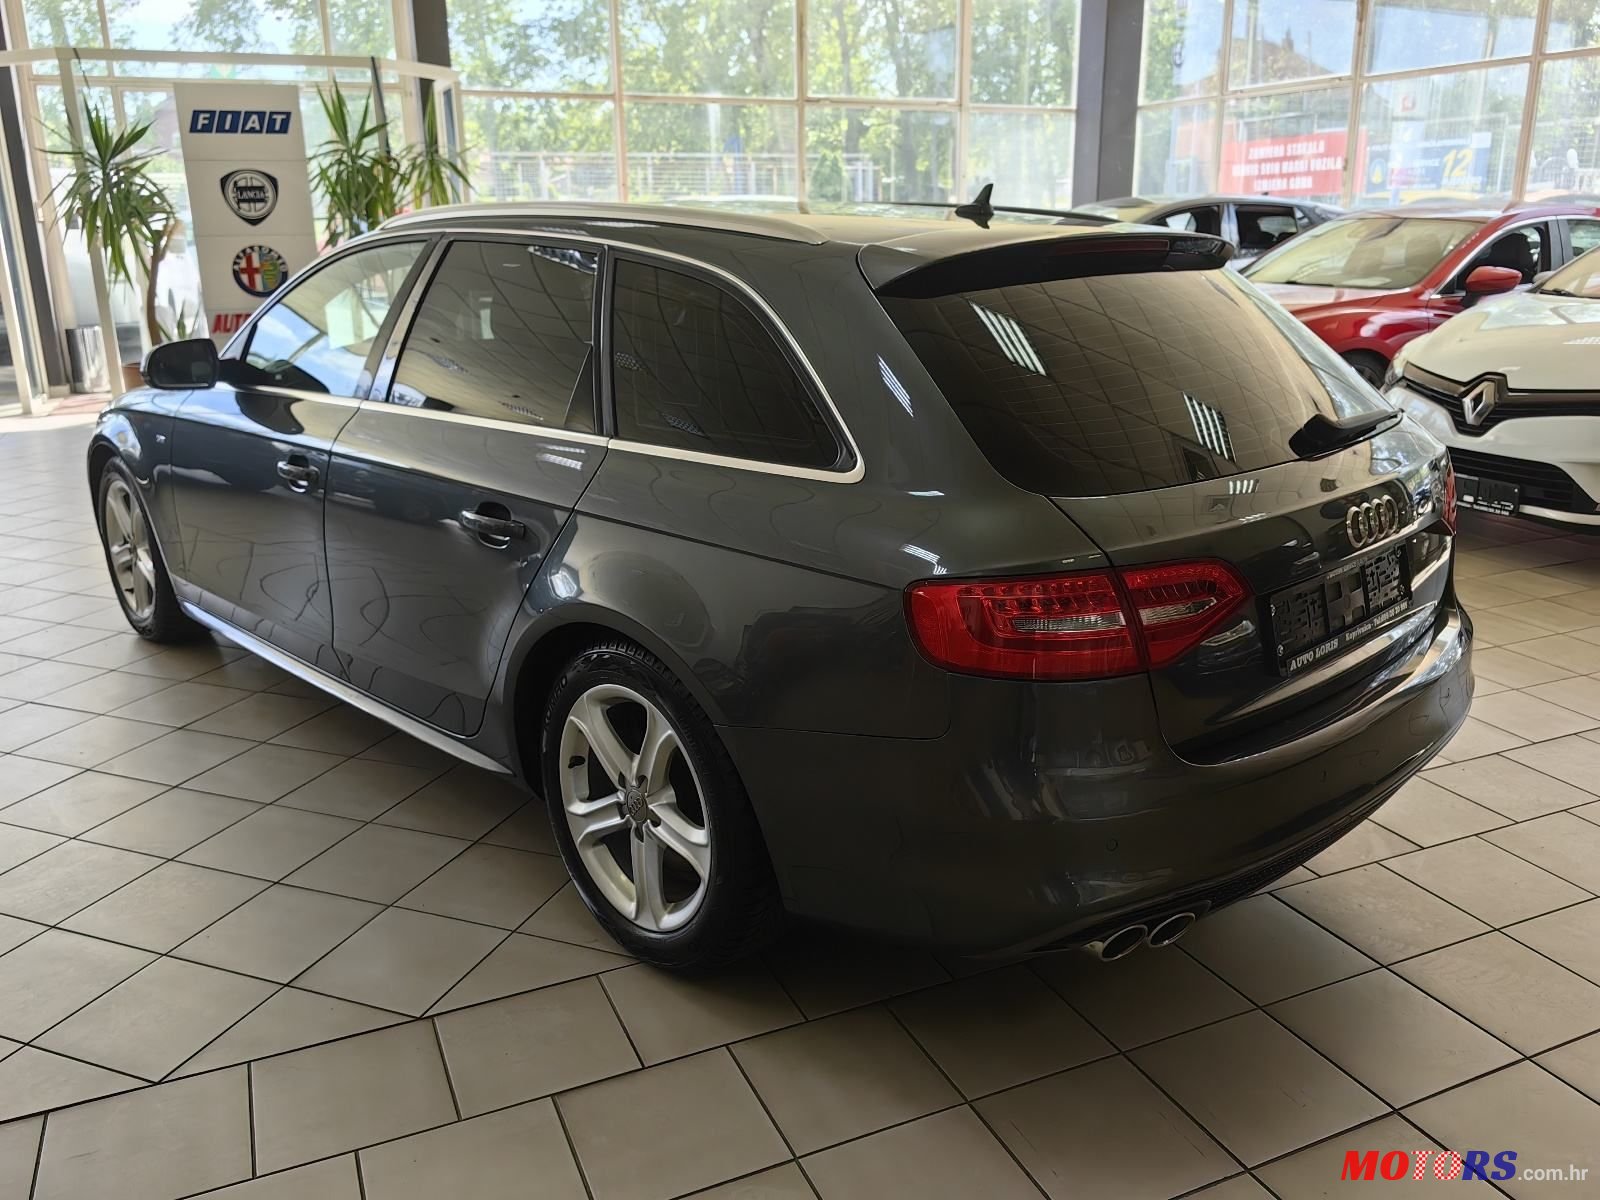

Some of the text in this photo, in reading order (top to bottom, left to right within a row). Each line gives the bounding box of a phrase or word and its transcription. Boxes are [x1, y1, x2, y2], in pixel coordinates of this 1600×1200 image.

[193, 111, 289, 133] FIAT
[1443, 148, 1473, 177] 12
[237, 189, 265, 200] LANCIA
[212, 313, 252, 333] AUT
[1290, 650, 1314, 672] AUTO
[1315, 638, 1339, 659] LORIS
